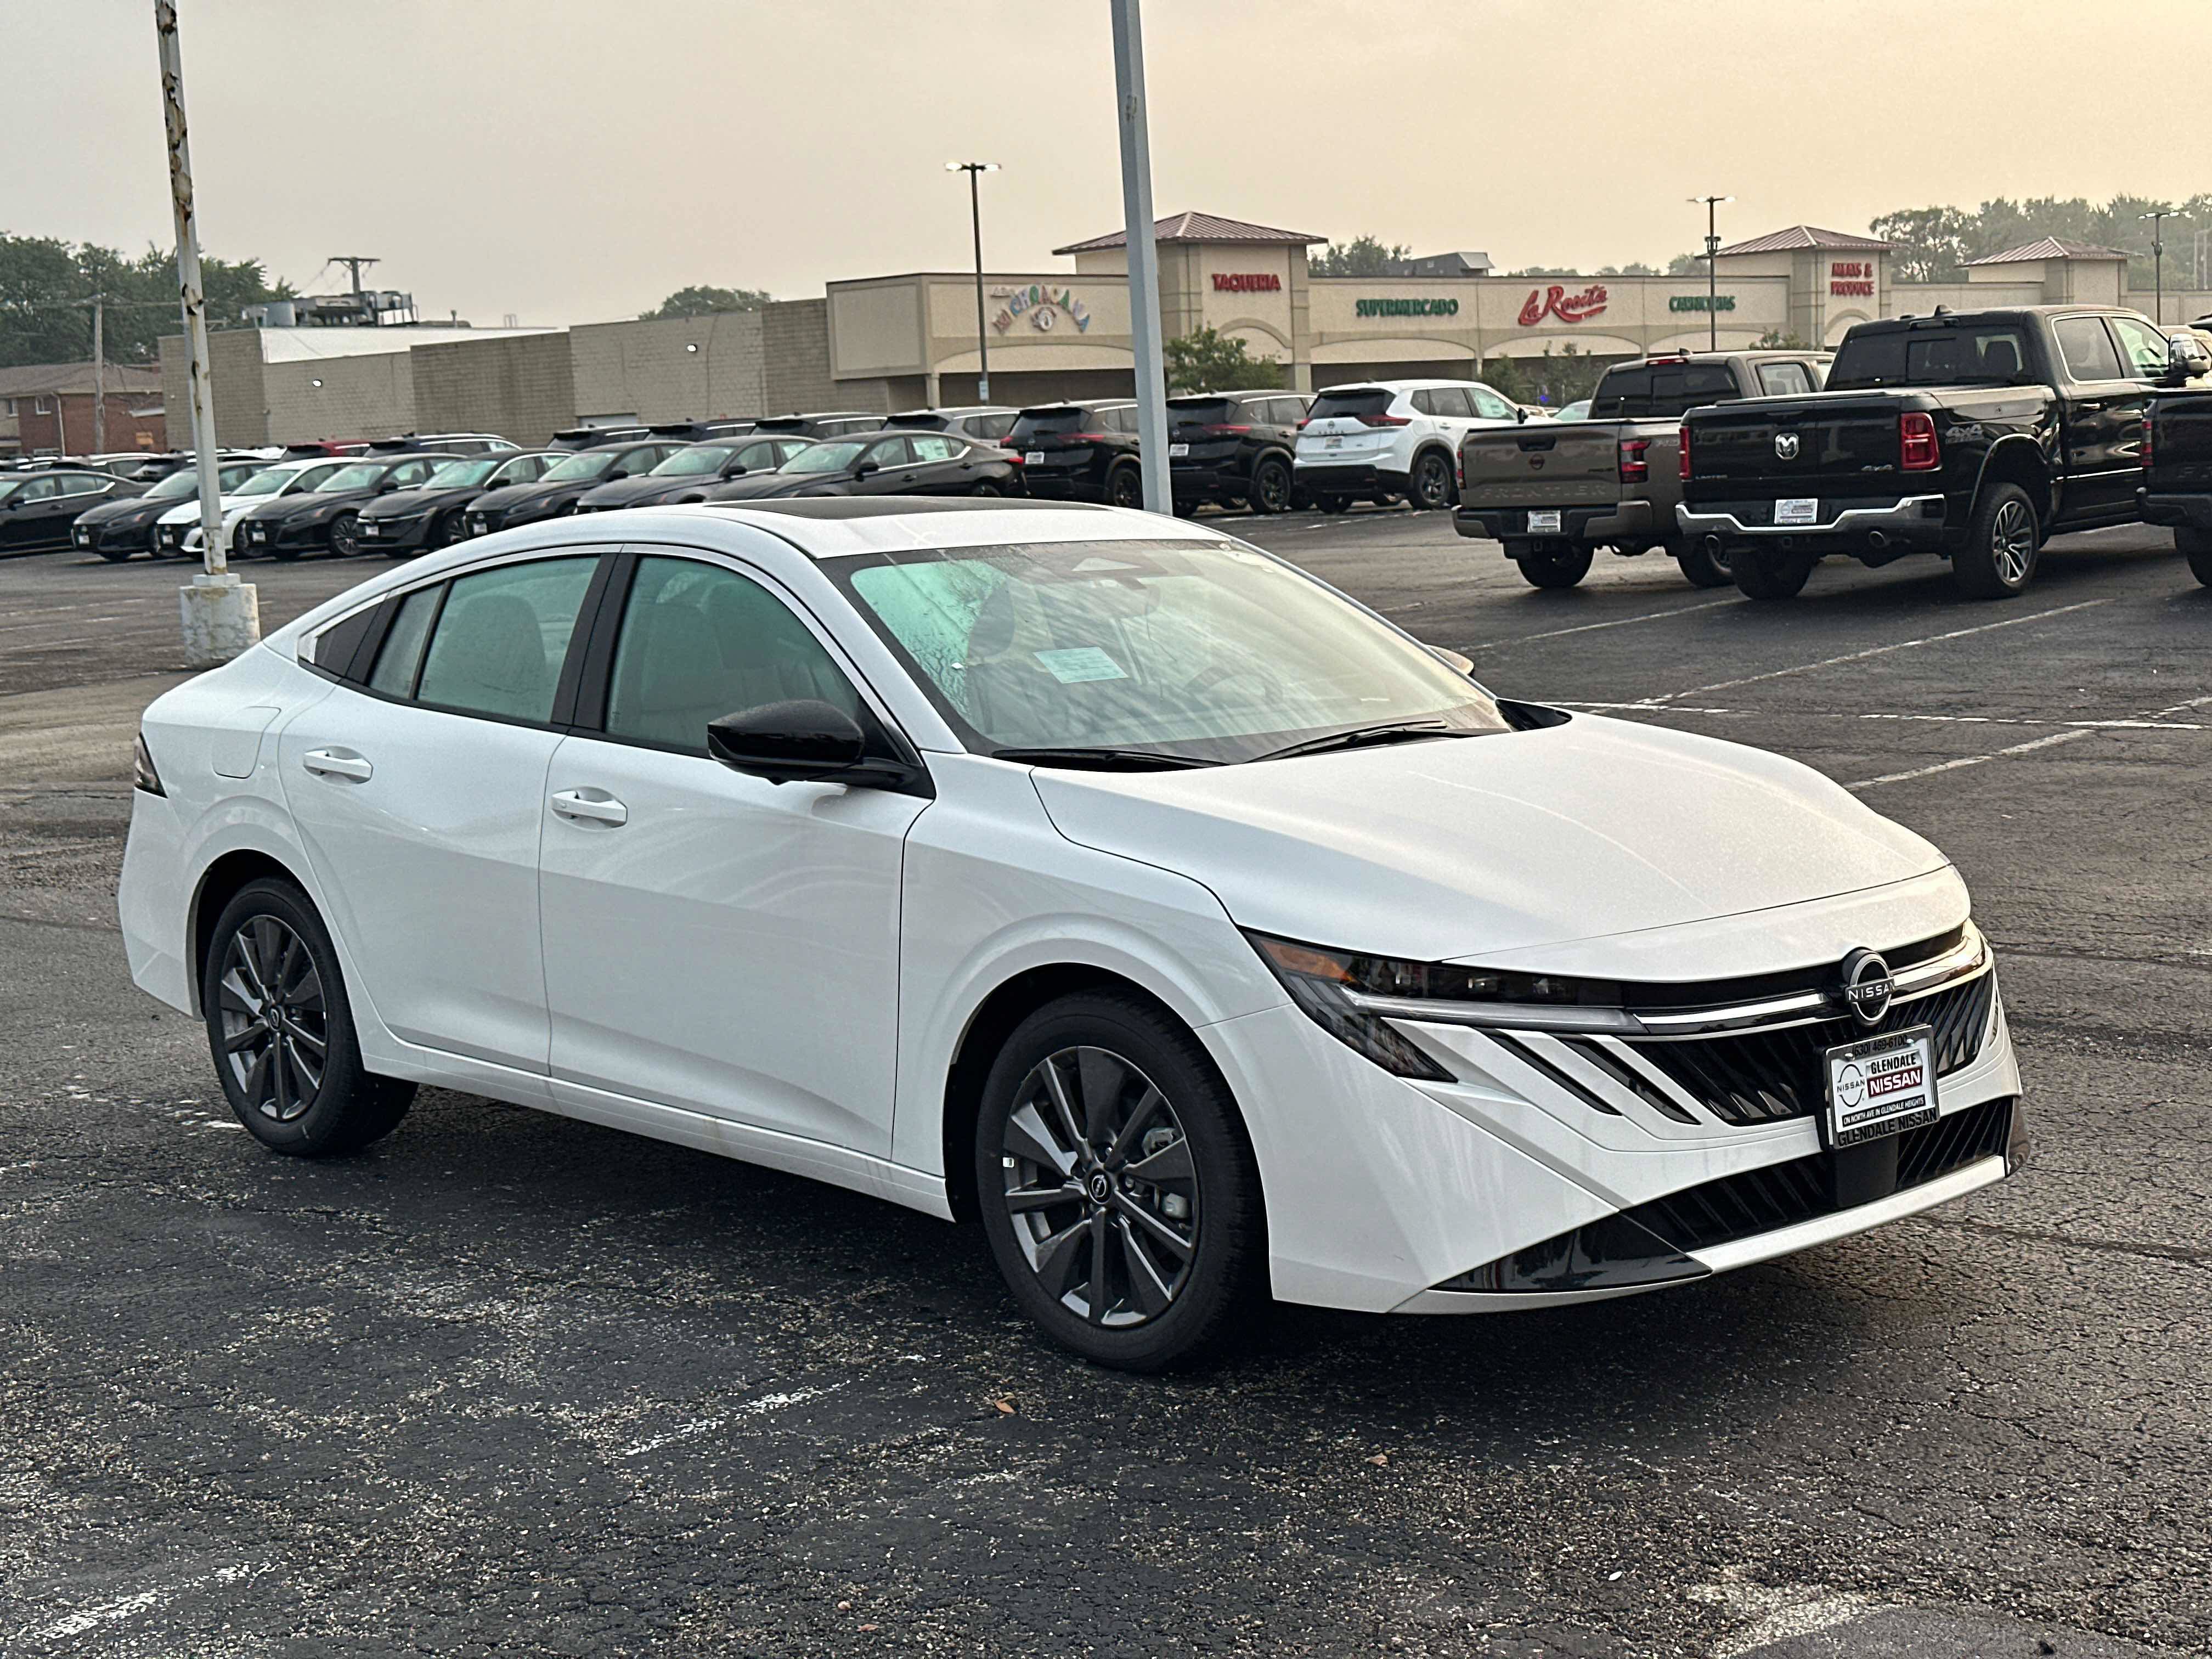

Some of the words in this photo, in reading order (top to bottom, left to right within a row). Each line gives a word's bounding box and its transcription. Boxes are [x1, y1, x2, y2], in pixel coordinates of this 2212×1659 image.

[1211, 273, 1282, 291] TAQUERIA
[1831, 280, 1875, 296] PRODUCE
[1356, 298, 1459, 317] SUPERMERCADO
[1518, 289, 1542, 326] La
[1542, 285, 1607, 323] Rosita
[1480, 484, 1606, 499] FRONTIER
[1848, 982, 1895, 1001] NISSAN
[1870, 1053, 1917, 1074] GLENDALE
[1837, 1078, 1865, 1093] NISSAN
[1869, 1070, 1921, 1095] NISSAN
[1851, 1113, 1865, 1123] NORTH
[1881, 1102, 1904, 1114] GLENDALE
[1904, 1097, 1924, 1108] HEIGHTS
[1838, 1120, 1895, 1147] GLENDALE
[1898, 1108, 1937, 1131] NISSAN
